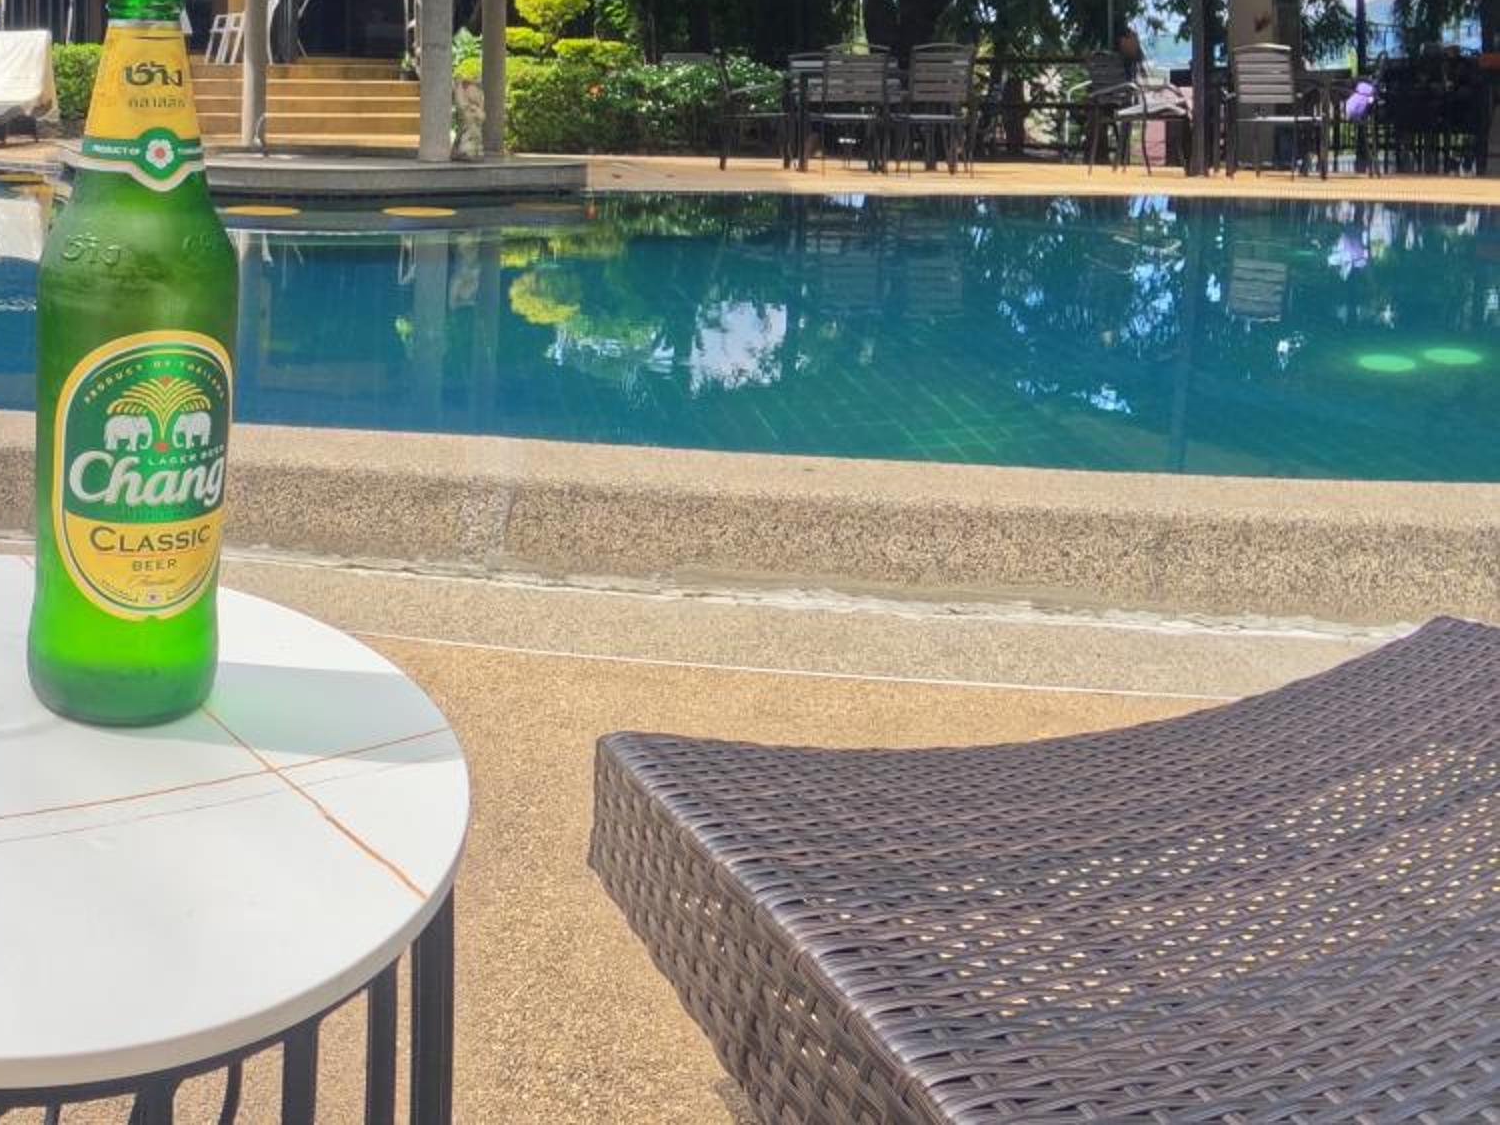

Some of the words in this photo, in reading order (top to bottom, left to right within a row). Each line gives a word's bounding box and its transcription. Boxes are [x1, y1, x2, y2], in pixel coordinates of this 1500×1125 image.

[124, 61, 183, 87] ช้าง
[69, 450, 226, 507] Chang
[89, 524, 211, 553] CLASSIC
[132, 558, 178, 572] BEER
